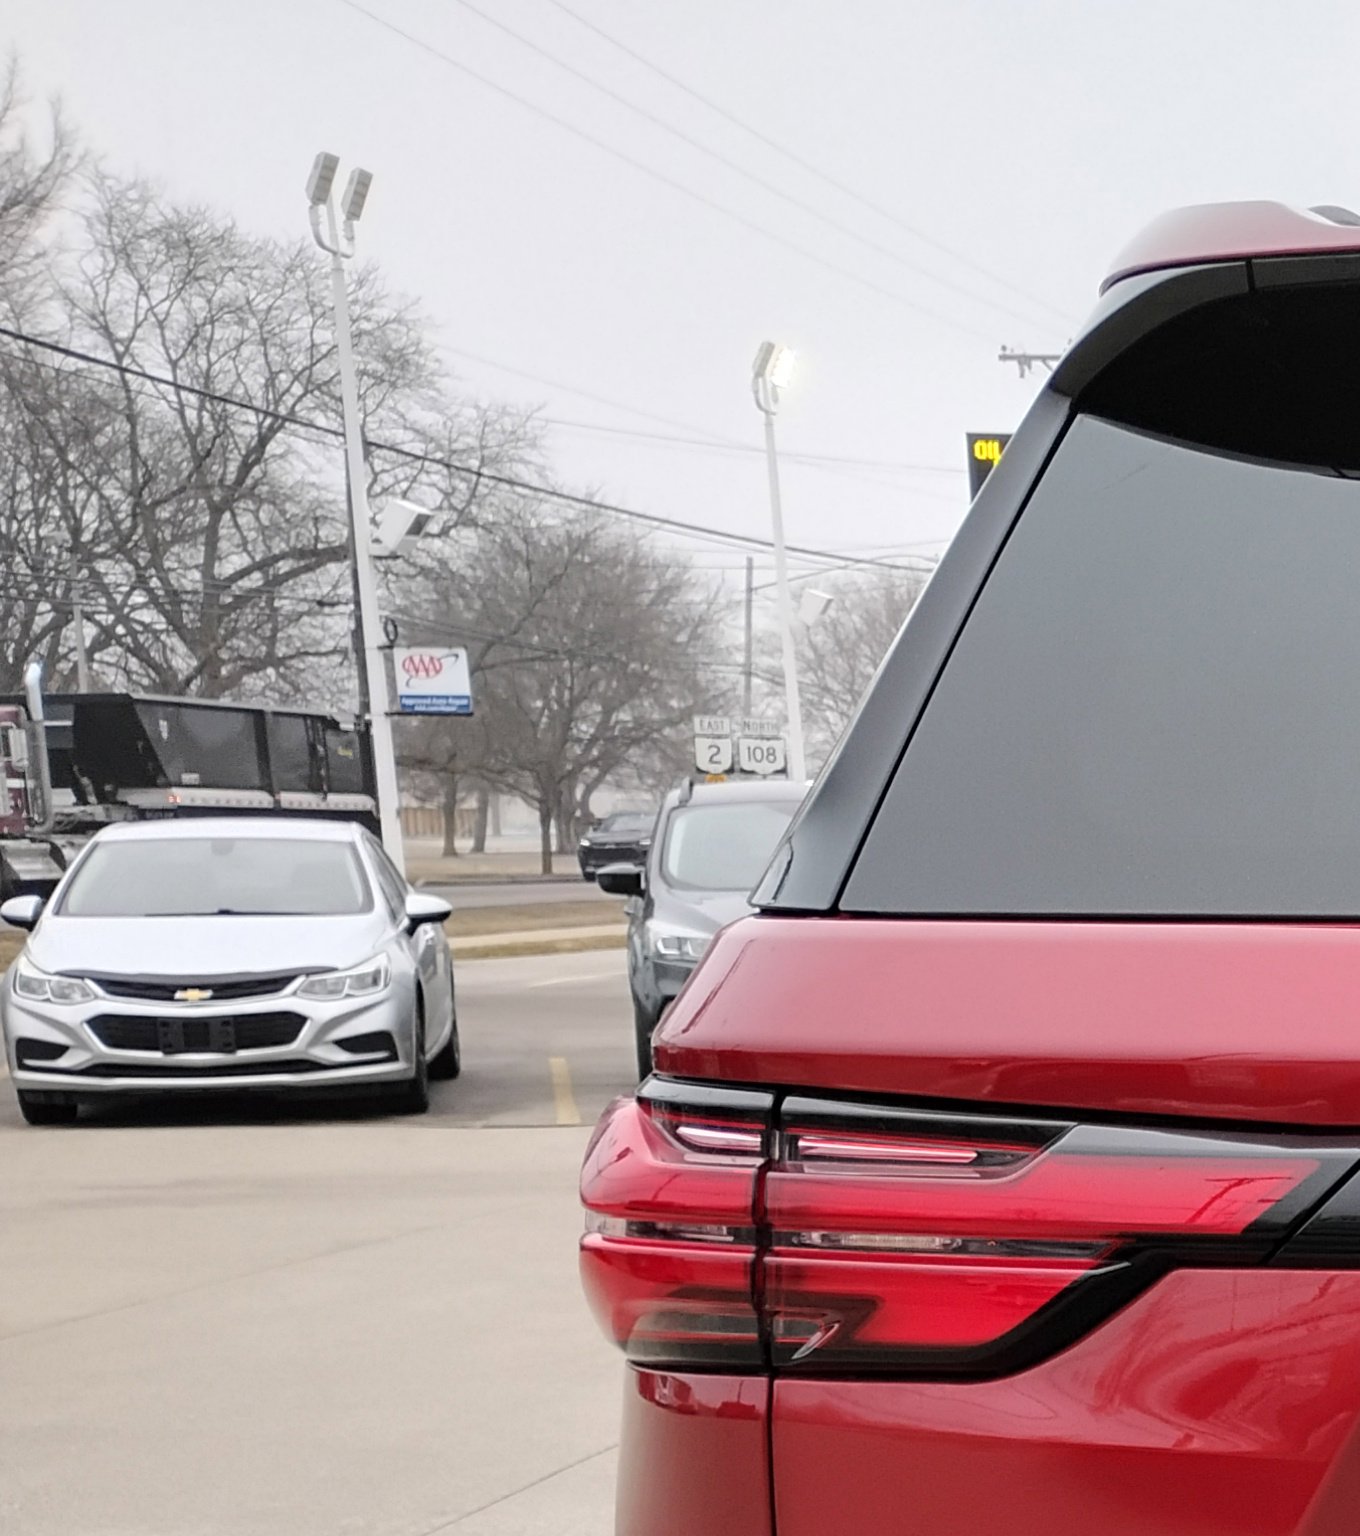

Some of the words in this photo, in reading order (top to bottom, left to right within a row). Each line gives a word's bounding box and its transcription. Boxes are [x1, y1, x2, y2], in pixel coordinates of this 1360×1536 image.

[699, 719, 725, 731] EAST
[707, 744, 722, 765] 2
[747, 746, 777, 764] 108
